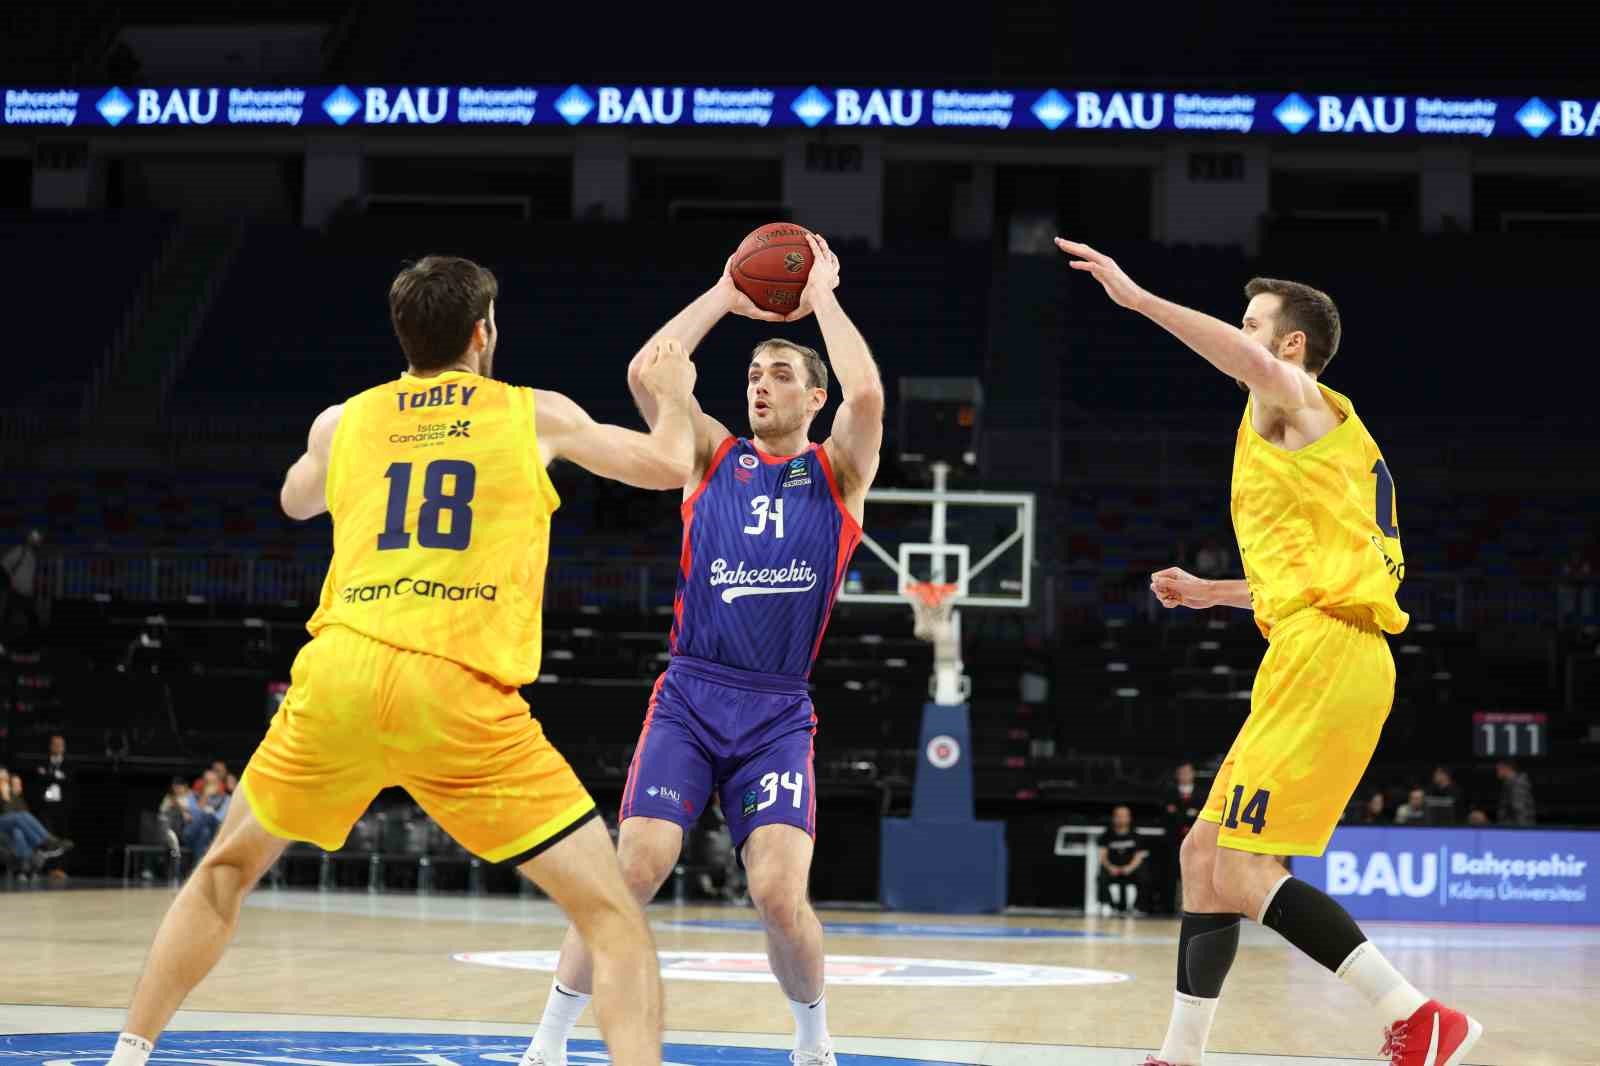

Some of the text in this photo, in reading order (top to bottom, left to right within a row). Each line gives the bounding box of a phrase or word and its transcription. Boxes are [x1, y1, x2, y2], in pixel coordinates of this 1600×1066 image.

[138, 89, 218, 123] BAU
[366, 88, 448, 123] BAU
[599, 88, 683, 123] BAU
[837, 90, 922, 125] BAU
[1077, 93, 1163, 129] BAU
[1319, 96, 1404, 132] BAU
[396, 384, 477, 411] TOBEY
[389, 432, 446, 444] Canarias
[417, 424, 447, 433] Islas
[377, 459, 476, 551] 18
[744, 495, 784, 539] 34
[1481, 723, 1539, 756] 111
[660, 786, 680, 801] BAU
[757, 771, 803, 811] 34
[1225, 784, 1270, 834] 14
[1326, 851, 1437, 897] BAU
